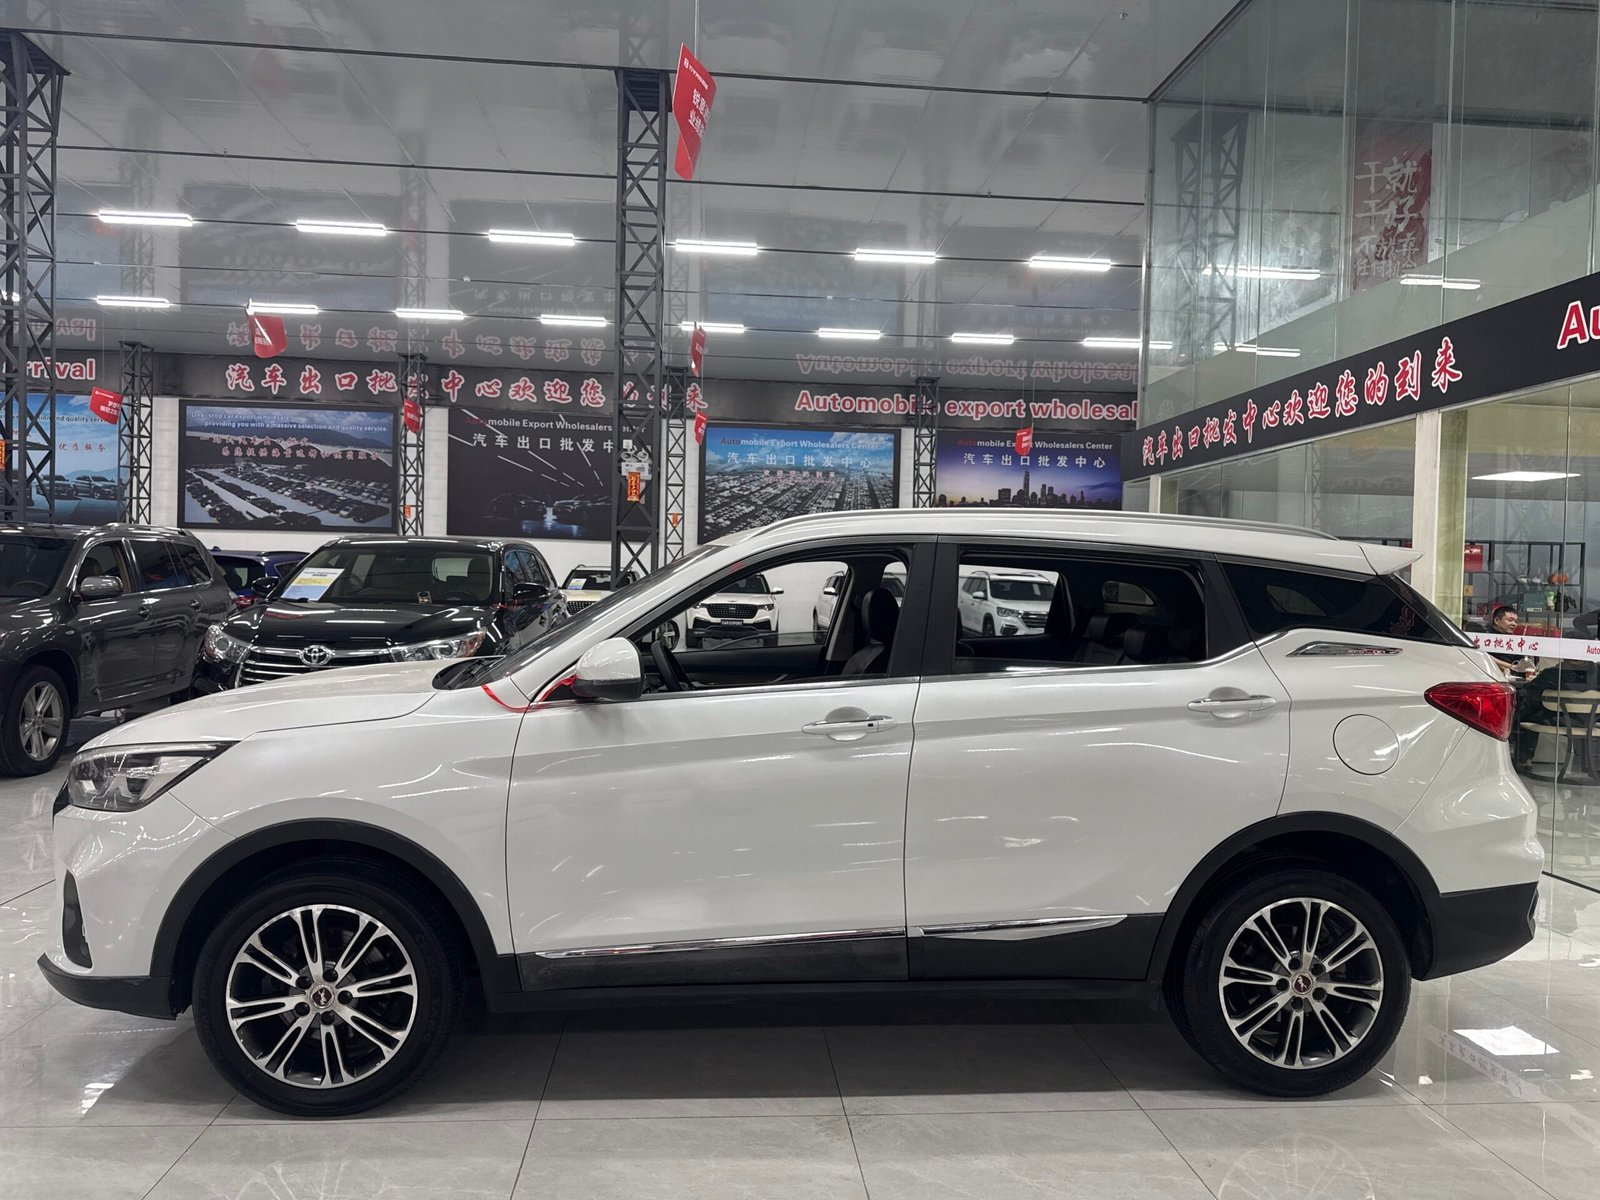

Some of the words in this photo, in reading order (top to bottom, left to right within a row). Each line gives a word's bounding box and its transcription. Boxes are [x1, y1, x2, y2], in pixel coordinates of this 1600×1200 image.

[1142, 336, 1462, 466] 汽车出口批发中心欢迎您的到来
[945, 399, 1026, 421] export
[522, 419, 554, 429] Export
[556, 421, 613, 431] Wholesalers
[770, 439, 798, 448] Export
[800, 440, 850, 449] Wholesalers
[1035, 441, 1084, 449] Wholesalers
[1085, 442, 1113, 450] Center
[727, 451, 872, 469] 汽车出口批发中心
[964, 453, 1106, 468] 汽车出口批发中心
